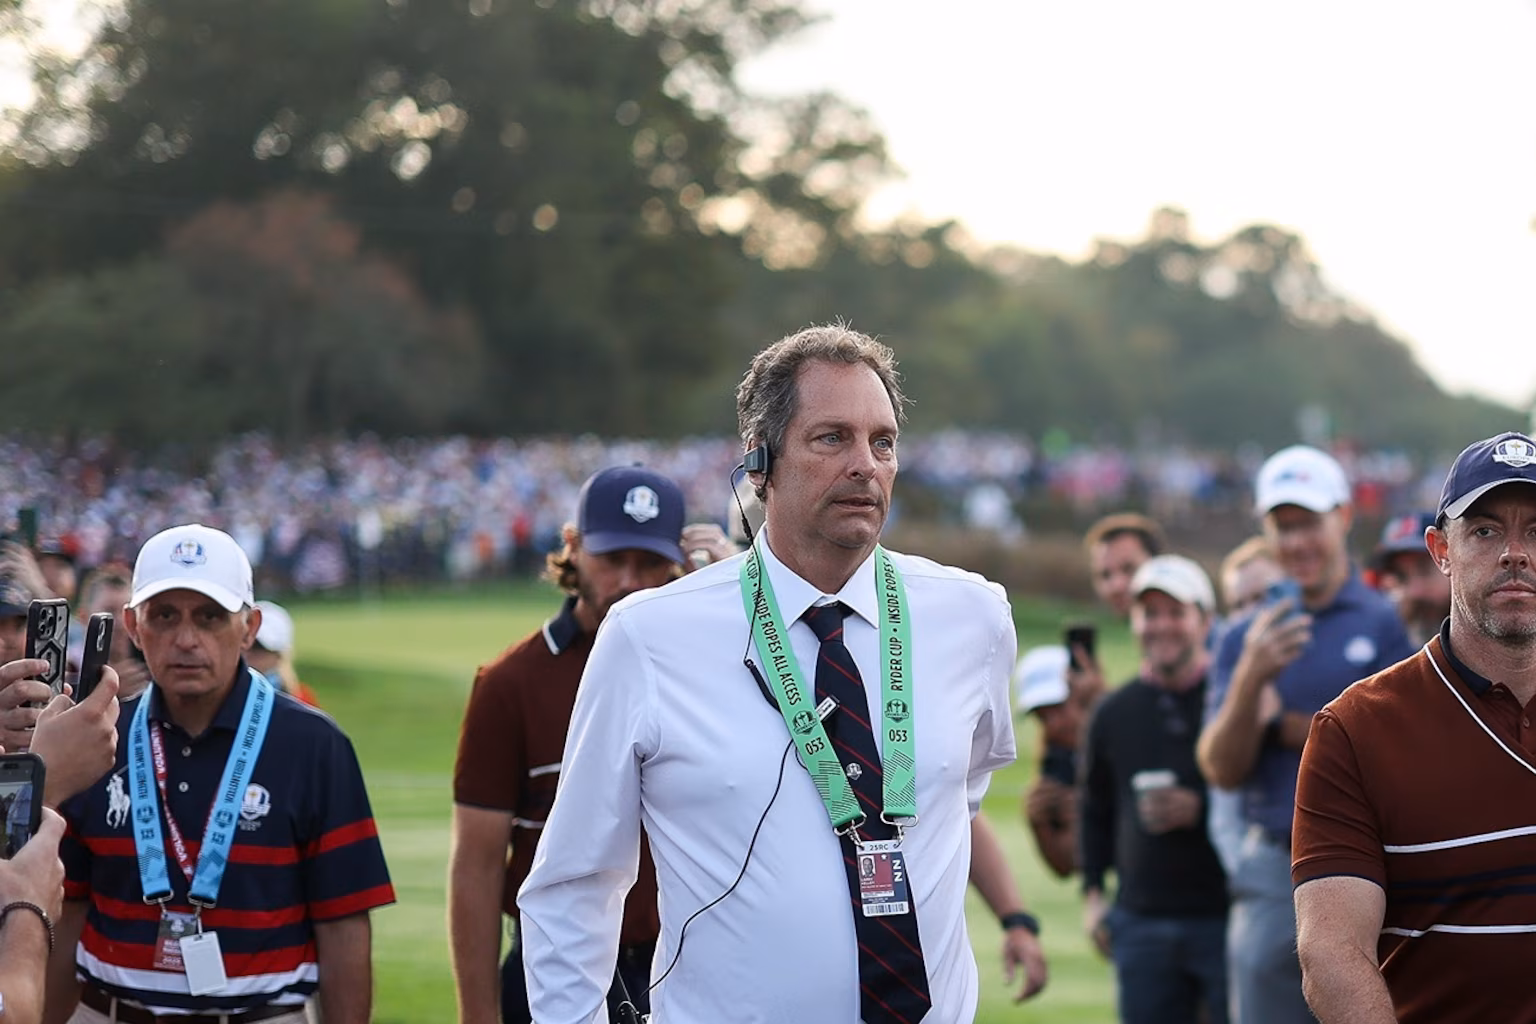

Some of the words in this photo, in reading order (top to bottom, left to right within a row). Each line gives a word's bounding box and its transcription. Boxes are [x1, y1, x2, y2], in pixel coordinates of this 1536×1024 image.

[883, 562, 897, 592] ROPES
[751, 588, 771, 621] INSIDE
[886, 592, 901, 624] INSIDE
[761, 621, 783, 654] ROPES
[889, 636, 903, 656] CUP
[772, 654, 788, 673] ALL
[890, 658, 903, 692] RYDER
[779, 672, 802, 706] ACCESS
[804, 737, 825, 756] 053
[889, 728, 908, 743] 053
